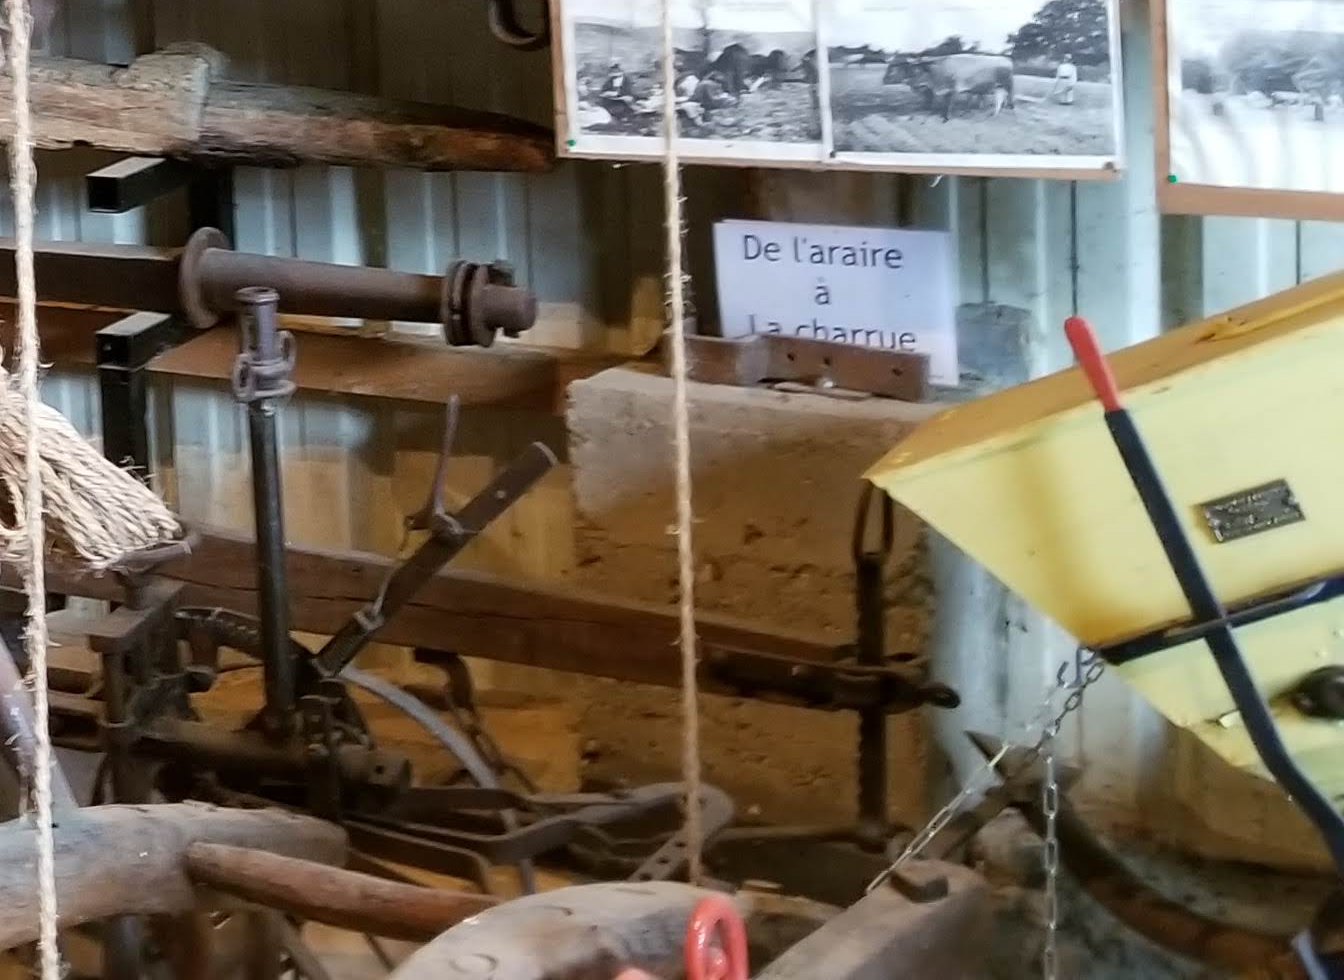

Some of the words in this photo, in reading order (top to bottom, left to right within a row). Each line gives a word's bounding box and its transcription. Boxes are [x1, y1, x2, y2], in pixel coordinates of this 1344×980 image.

[743, 234, 781, 262] De
[793, 236, 904, 269] l'araire
[815, 277, 831, 305] à
[795, 318, 916, 351] charrue
